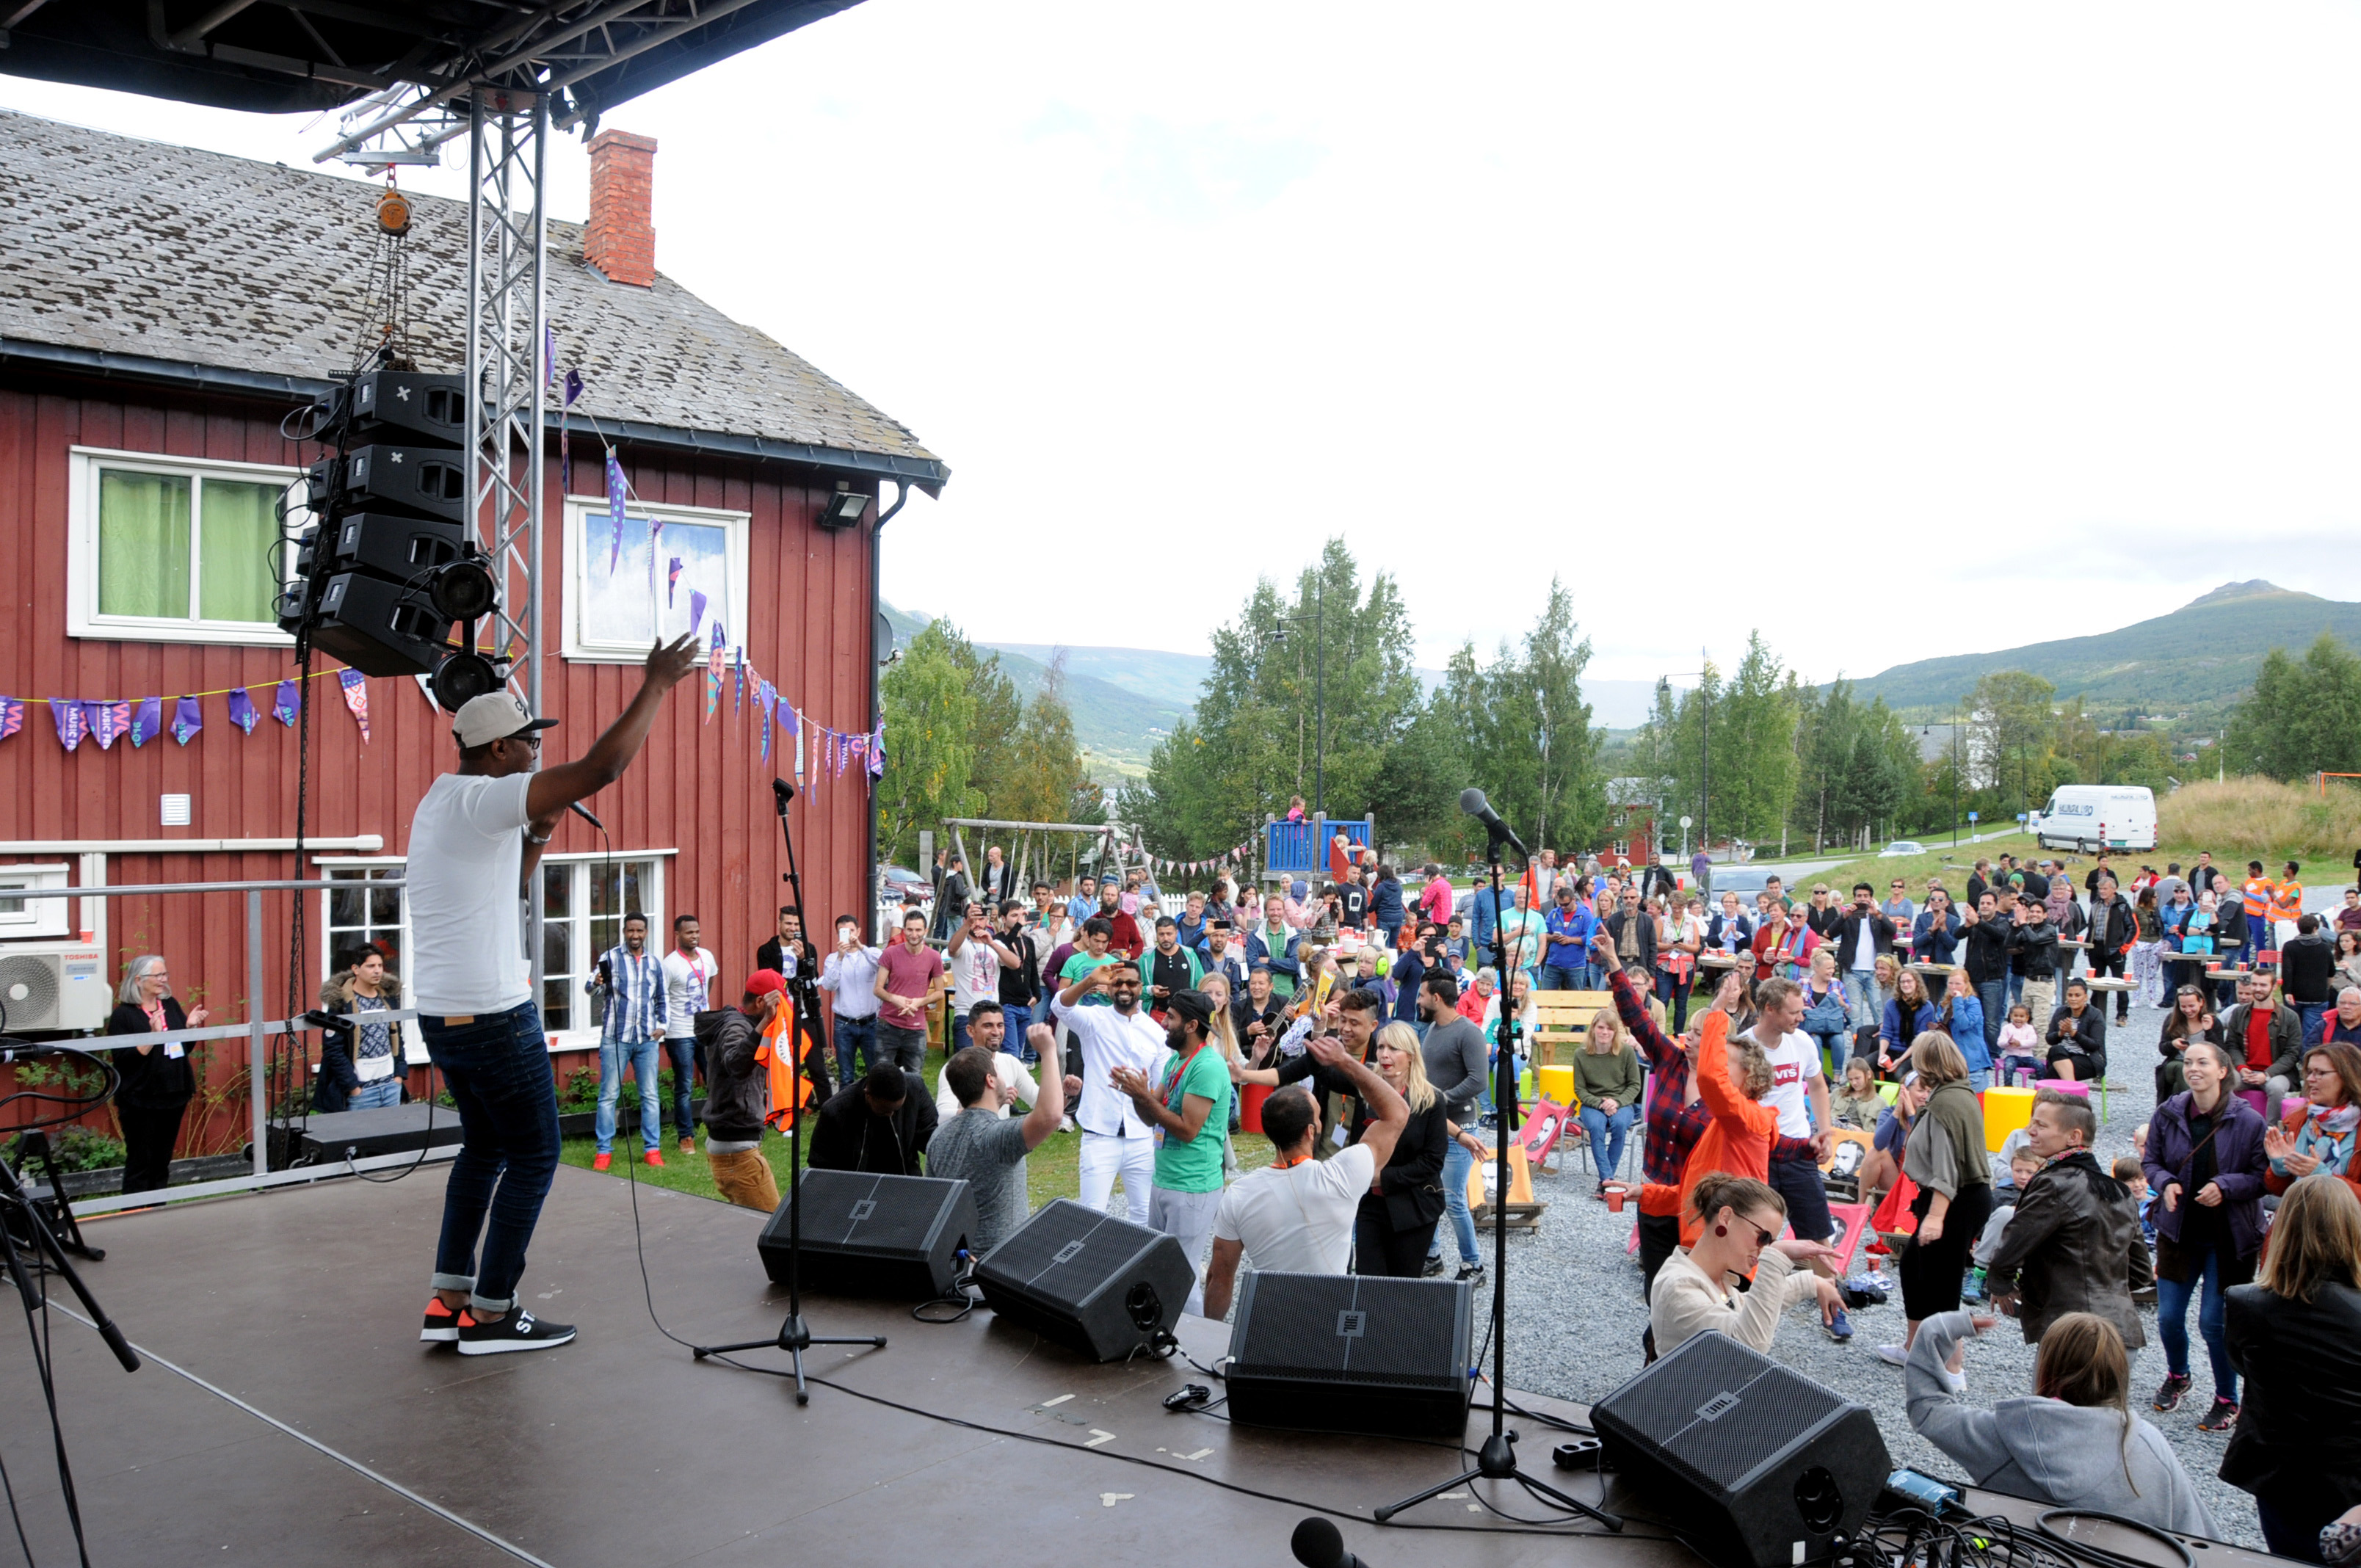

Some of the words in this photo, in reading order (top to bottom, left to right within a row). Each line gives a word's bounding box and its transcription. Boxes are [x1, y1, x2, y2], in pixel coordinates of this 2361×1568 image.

[68, 707, 79, 738] MUSIC
[101, 705, 111, 732] MUSIC
[178, 723, 188, 745] 016
[1774, 1068, 1797, 1079] VI'S
[855, 1204, 871, 1216] JBL
[1059, 1246, 1078, 1258] JBL
[516, 1310, 536, 1333] ST
[1343, 1315, 1358, 1332] JBL
[1705, 1399, 1732, 1415] JBL
